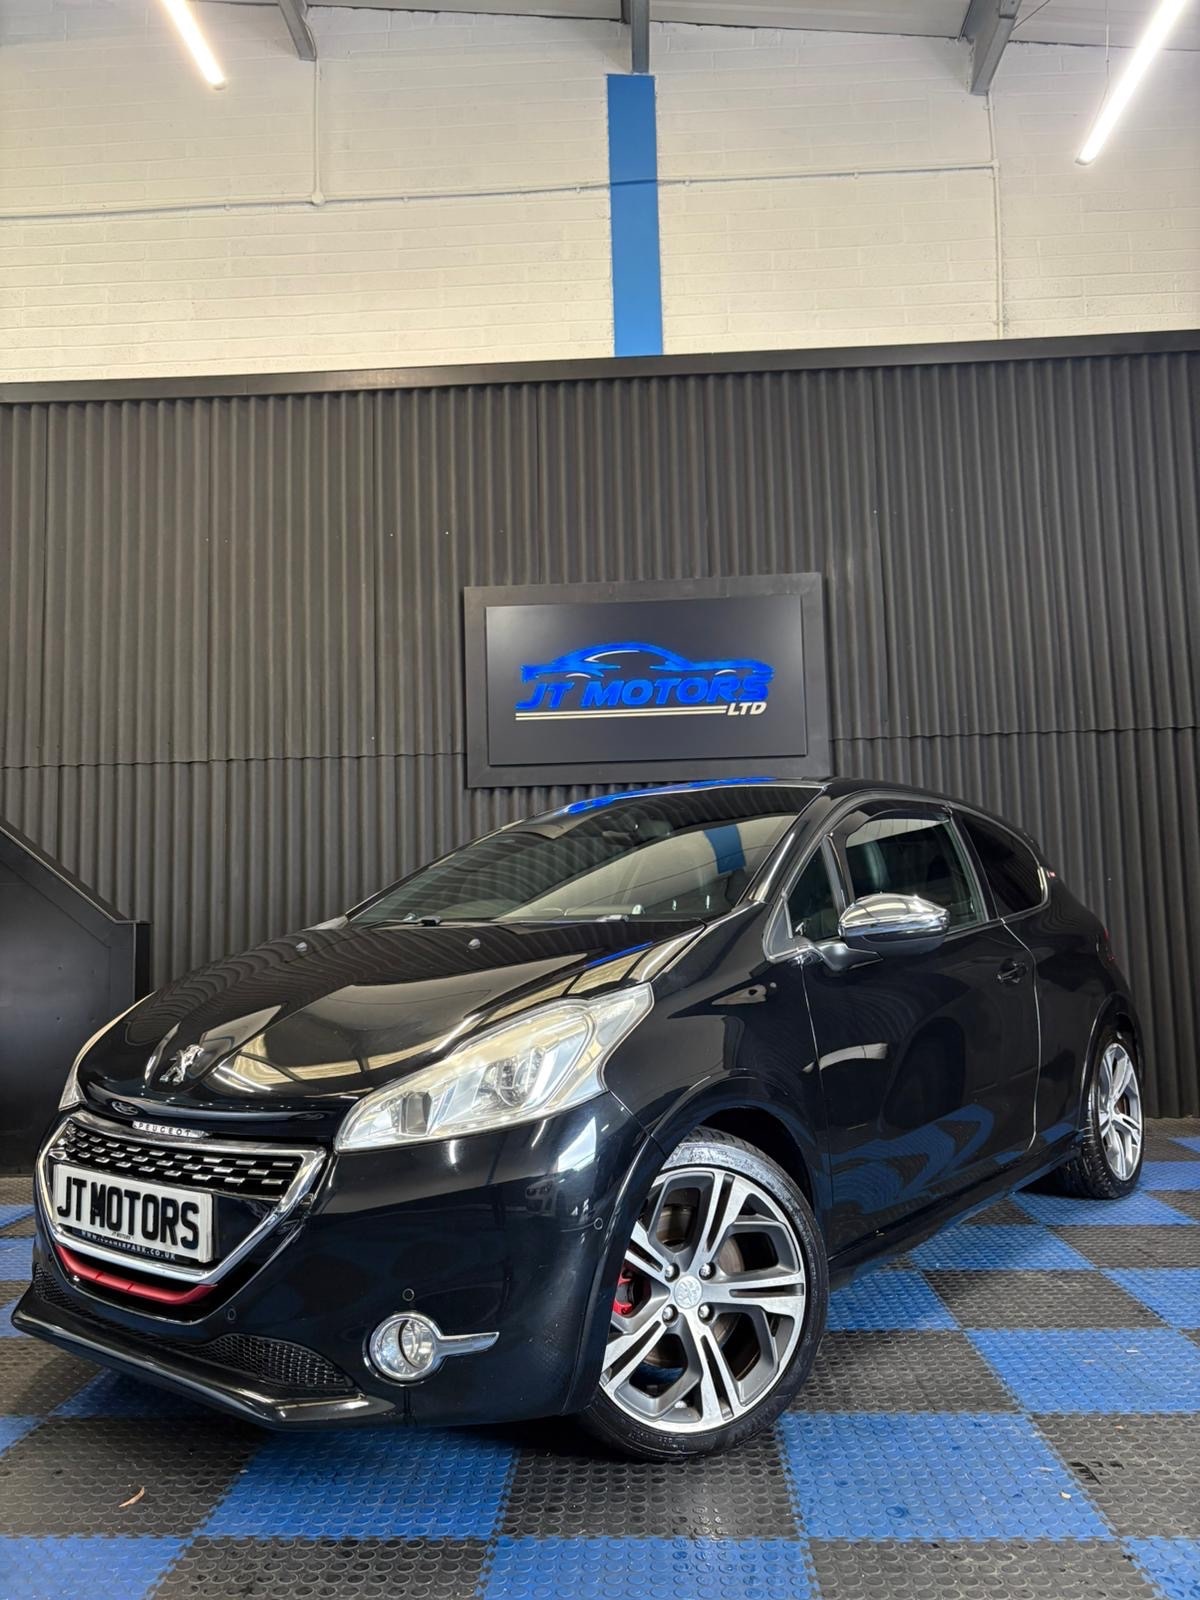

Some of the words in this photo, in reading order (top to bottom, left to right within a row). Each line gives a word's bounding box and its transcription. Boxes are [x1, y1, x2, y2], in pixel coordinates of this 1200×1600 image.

[515, 682, 575, 710] JT
[580, 675, 769, 708] MOTORS
[727, 701, 768, 716] LTD
[138, 1121, 192, 1137] PEUGEOT
[57, 1175, 88, 1222] JT
[90, 1181, 201, 1250] MOTORS
